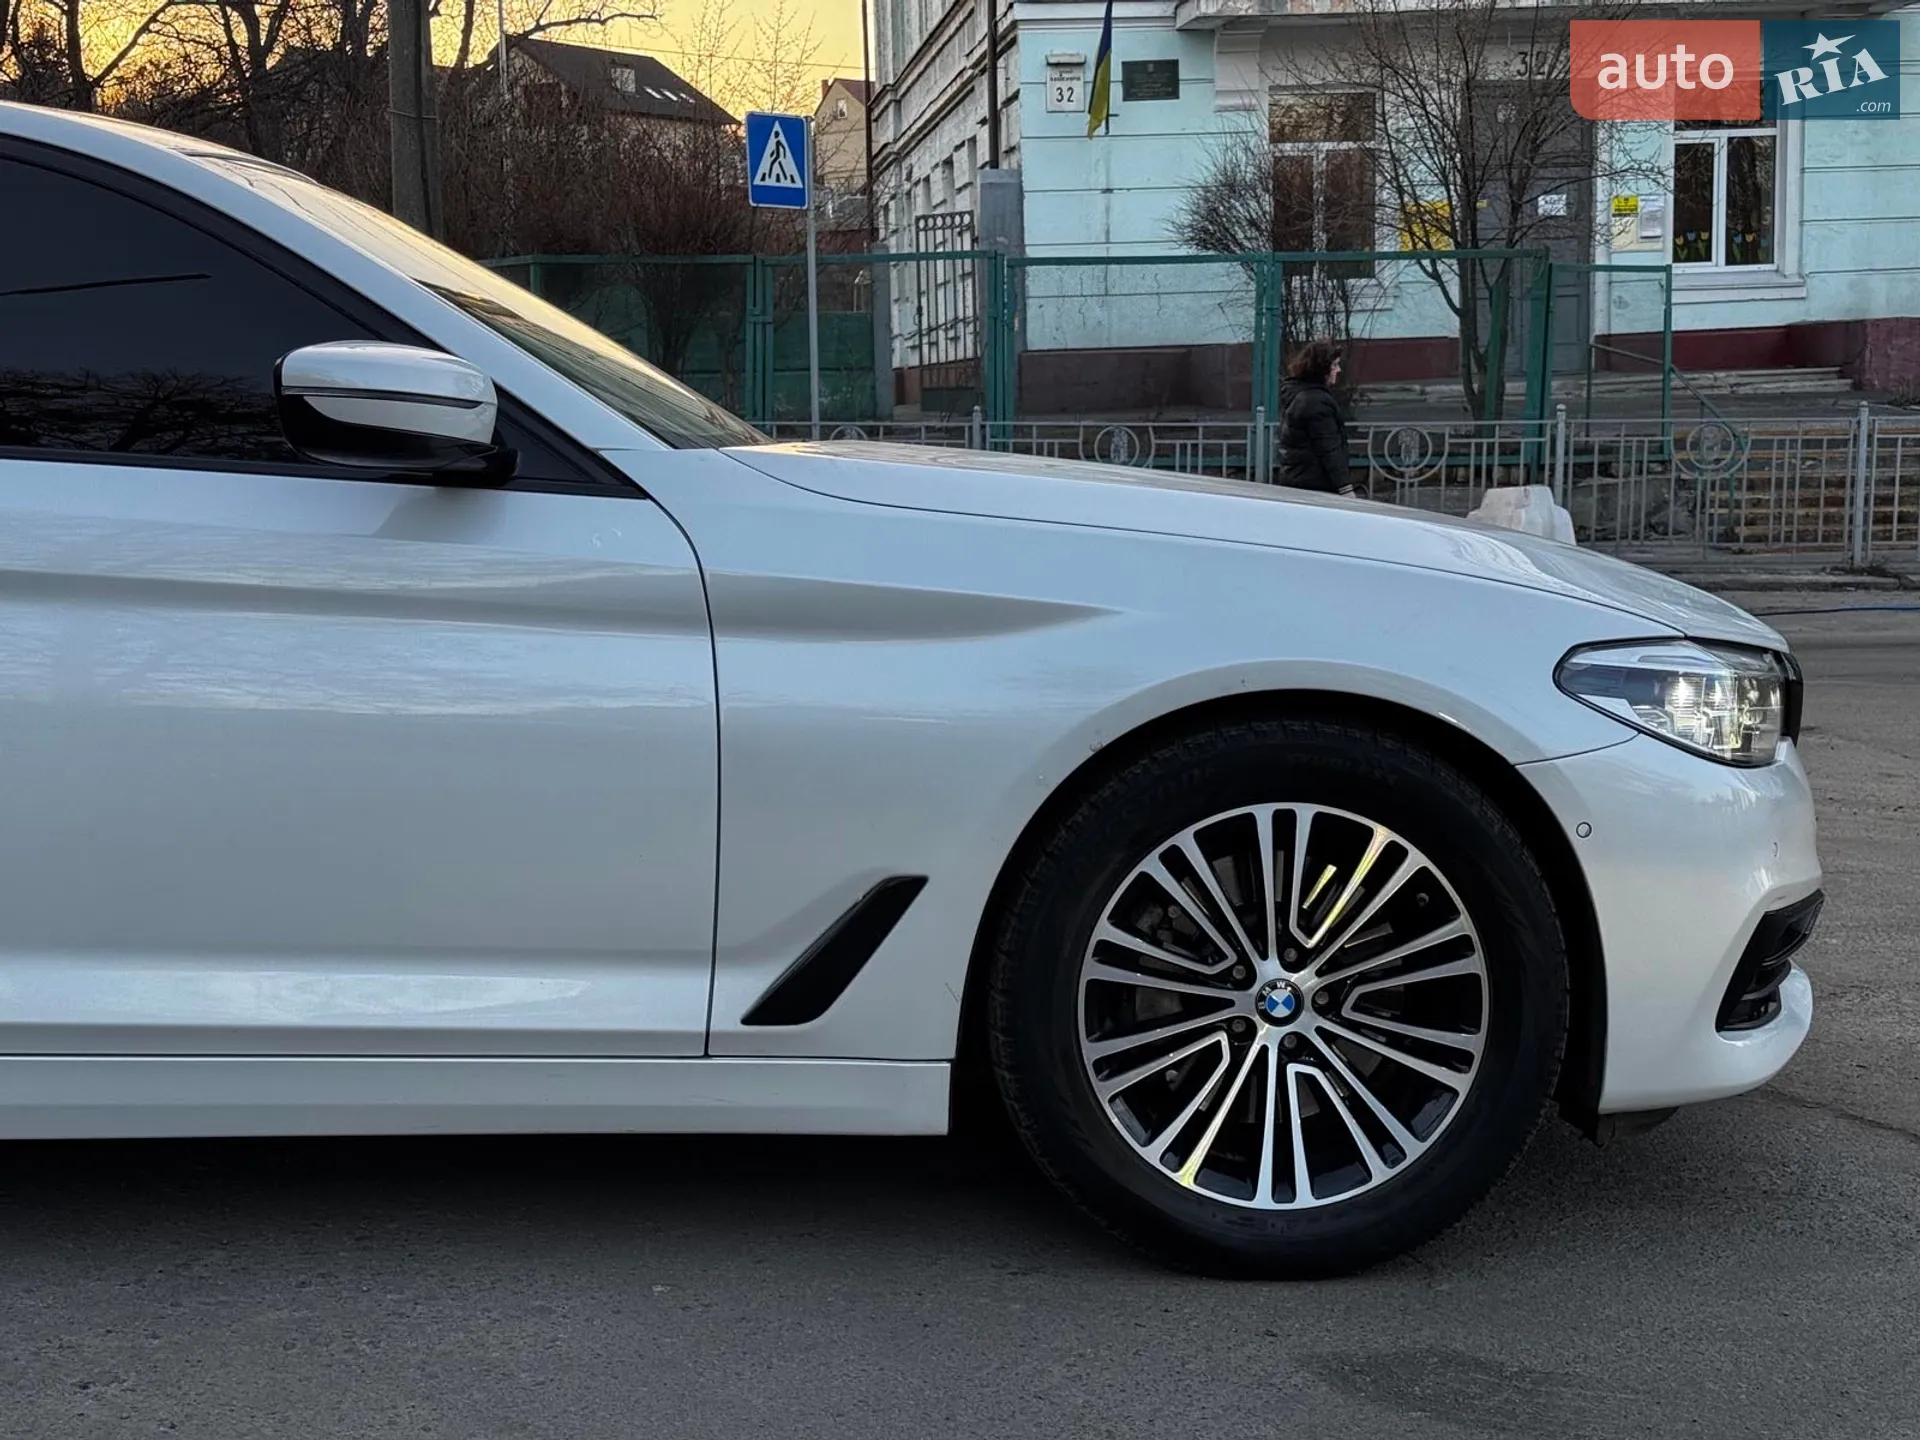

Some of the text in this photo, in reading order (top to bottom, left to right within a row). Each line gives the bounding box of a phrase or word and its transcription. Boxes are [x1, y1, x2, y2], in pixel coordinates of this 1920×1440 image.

[1516, 51, 1546, 77] 32
[1055, 86, 1075, 103] 32
[1258, 981, 1286, 1010] BMW
